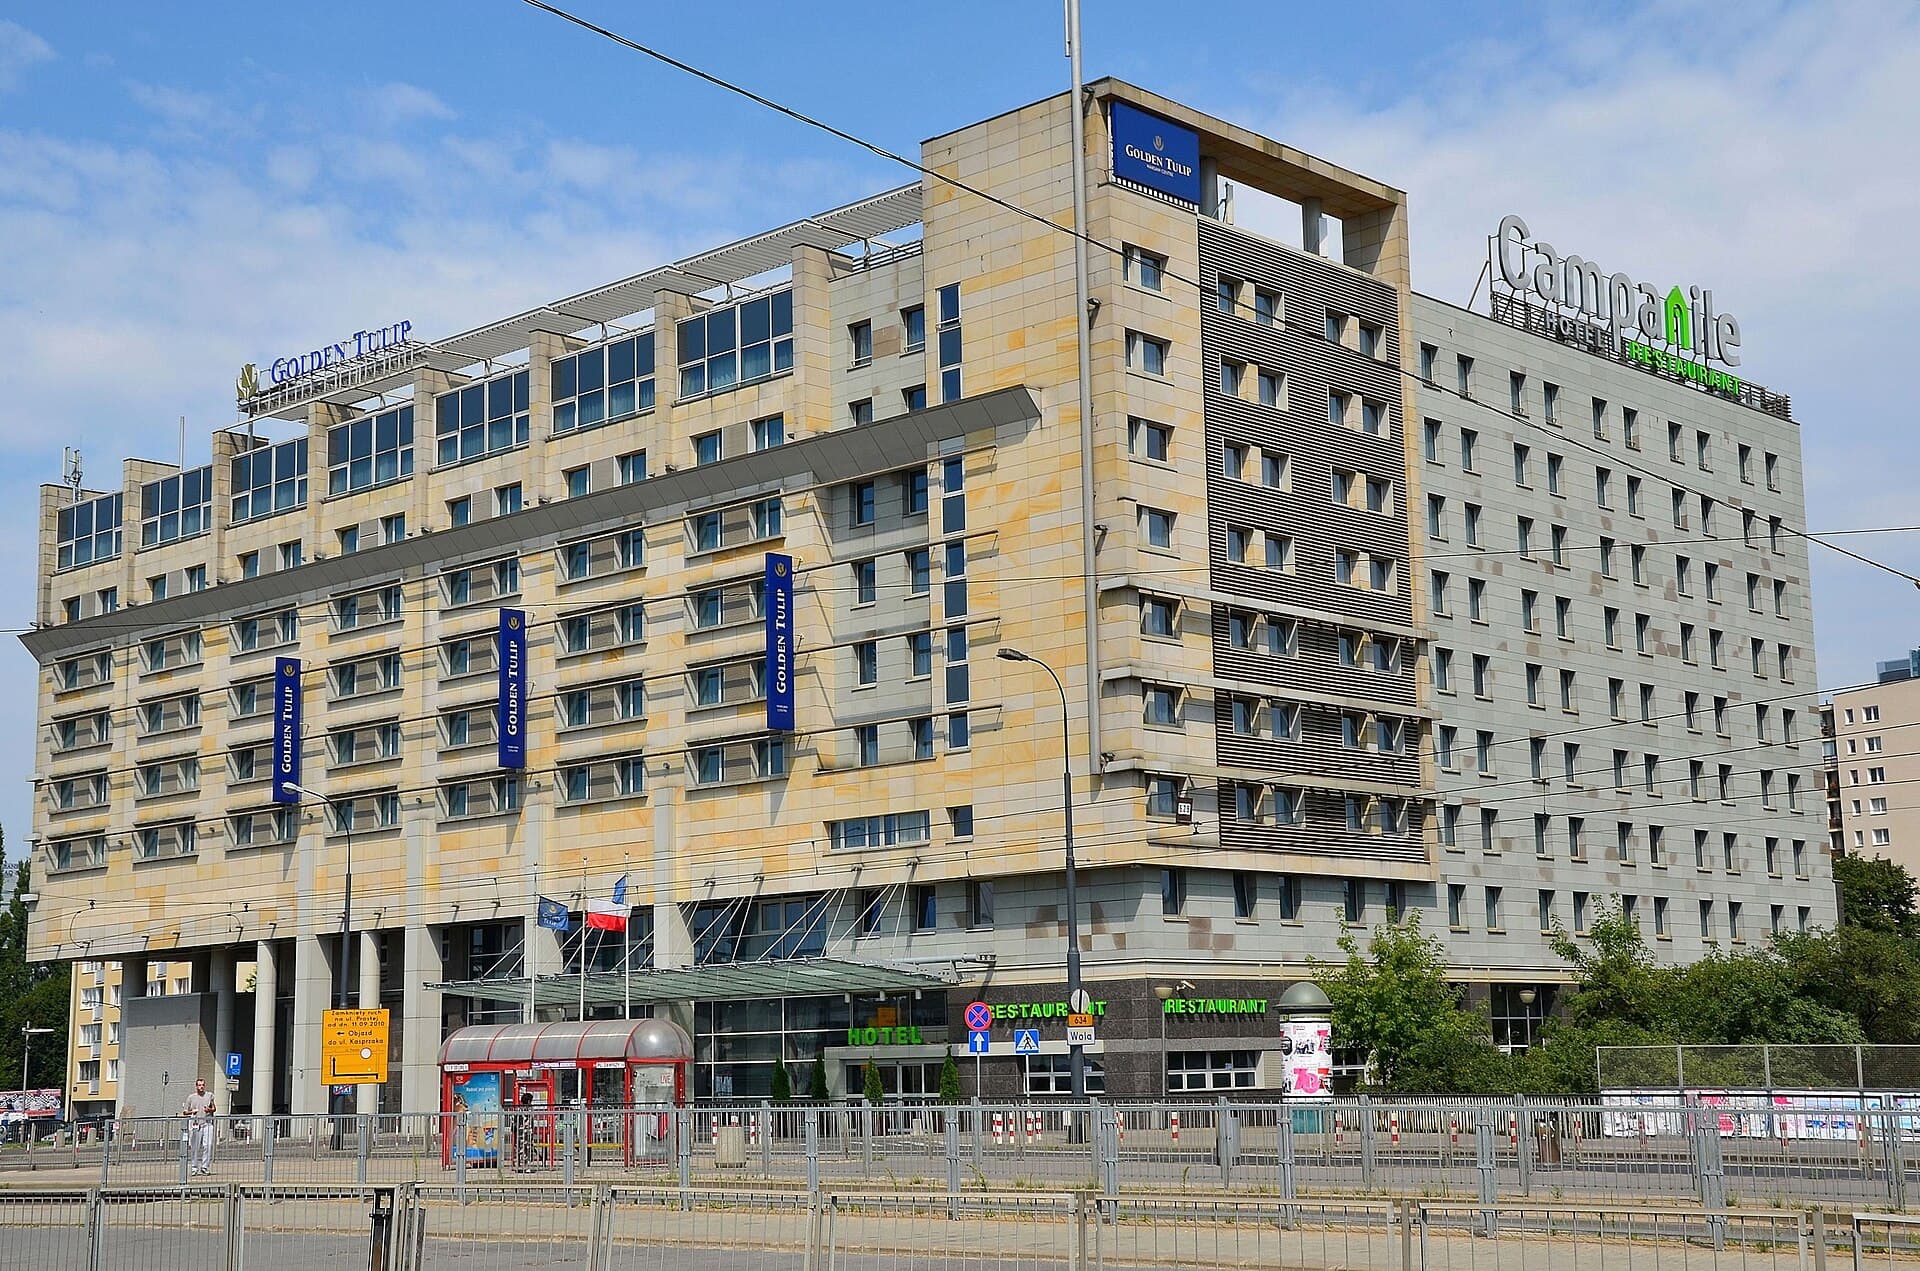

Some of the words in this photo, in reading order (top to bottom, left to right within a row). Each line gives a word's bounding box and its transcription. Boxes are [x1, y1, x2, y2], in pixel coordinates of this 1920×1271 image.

[1125, 144, 1163, 167] GOLDEN
[1165, 157, 1192, 177] TULIP
[1498, 214, 1741, 367] Campanile
[1545, 310, 1604, 348] HOTEL
[271, 339, 346, 385] GOLDEN
[352, 319, 412, 357] TULIP
[1628, 341, 1741, 395] RESTAURANT
[775, 588, 787, 631] TULIP
[508, 640, 518, 679] TULIP
[776, 635, 787, 694] GOLDEN
[282, 686, 293, 721] TULIP
[507, 682, 518, 736] GOLDEN
[281, 724, 293, 774] GOLDEN
[1073, 1016, 1087, 1025] 634
[1164, 998, 1267, 1014] RESTAURANT
[847, 1026, 924, 1046] HOTEL
[1070, 1032, 1093, 1041] Wola
[230, 1055, 239, 1069] P
